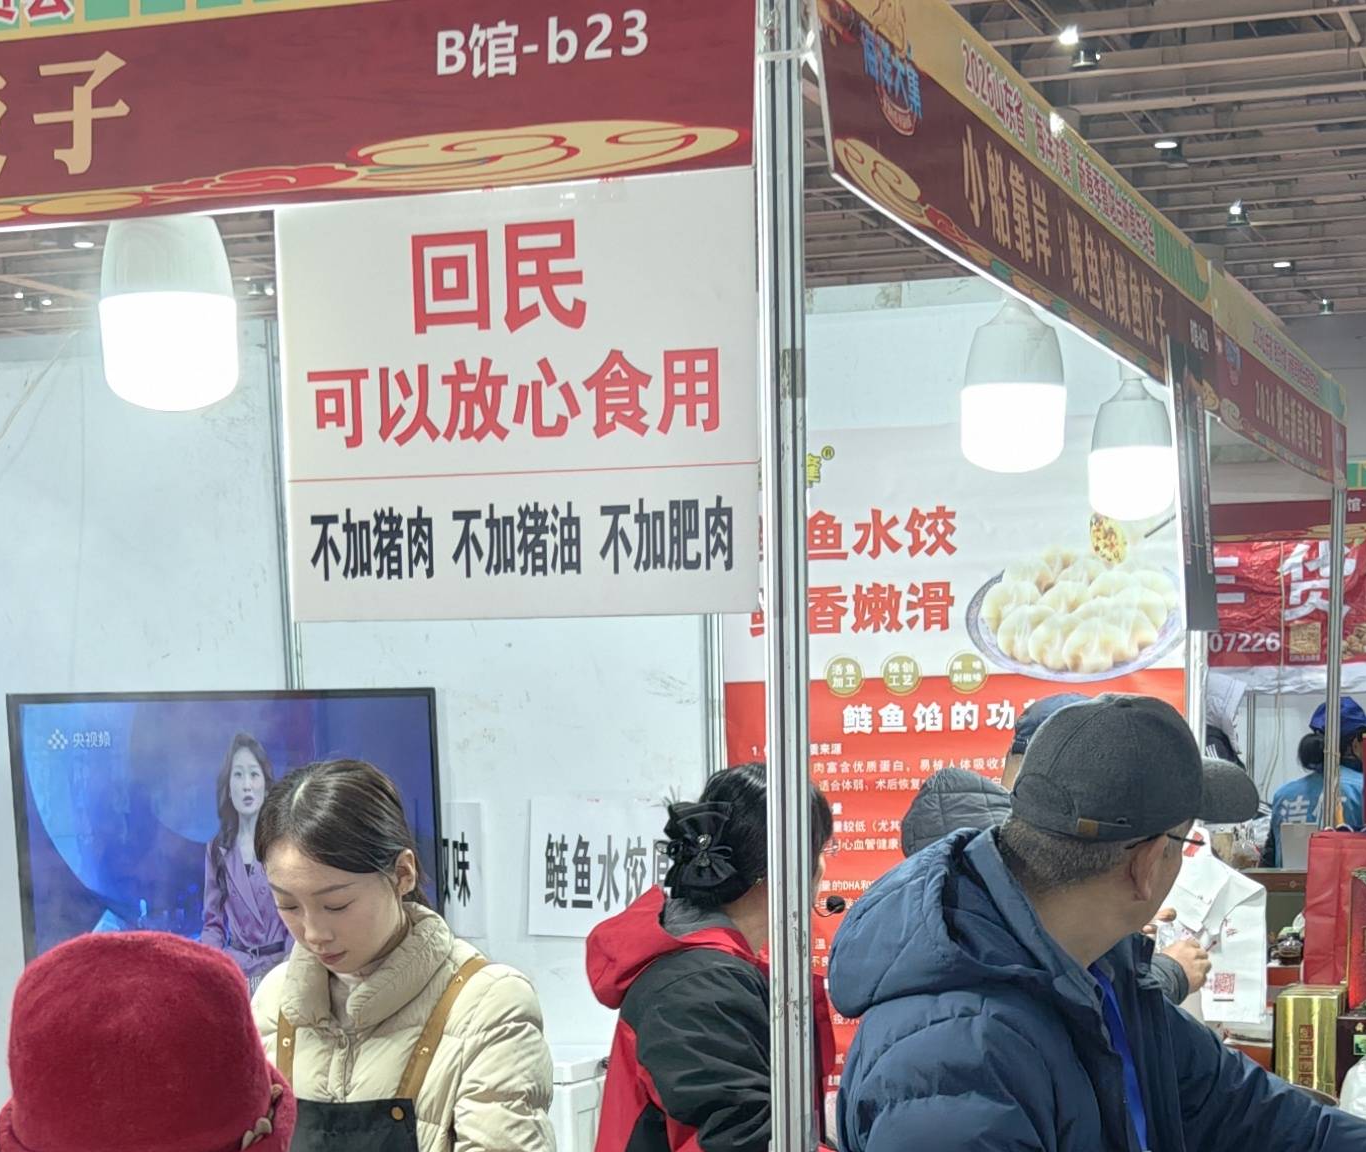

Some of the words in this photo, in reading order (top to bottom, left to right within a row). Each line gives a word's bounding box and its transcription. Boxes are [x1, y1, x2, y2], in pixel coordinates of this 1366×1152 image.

[436, 10, 649, 79] B馆-b23
[961, 124, 1051, 277] 小船靠岸
[411, 219, 587, 334] 回民
[307, 347, 720, 449] 可以放心食用
[310, 505, 435, 582] 不加猪肉
[451, 501, 582, 577] 不加猪油
[600, 495, 734, 573] 不加肥肉
[758, 505, 958, 562] 鱼水饺
[748, 580, 956, 638] 香嫩滑
[1209, 632, 1281, 653] 07226
[831, 677, 857, 689] 加工
[889, 675, 914, 687] 工艺
[73, 730, 112, 749] 央视频
[842, 699, 1036, 735] 鲢鱼馅的功
